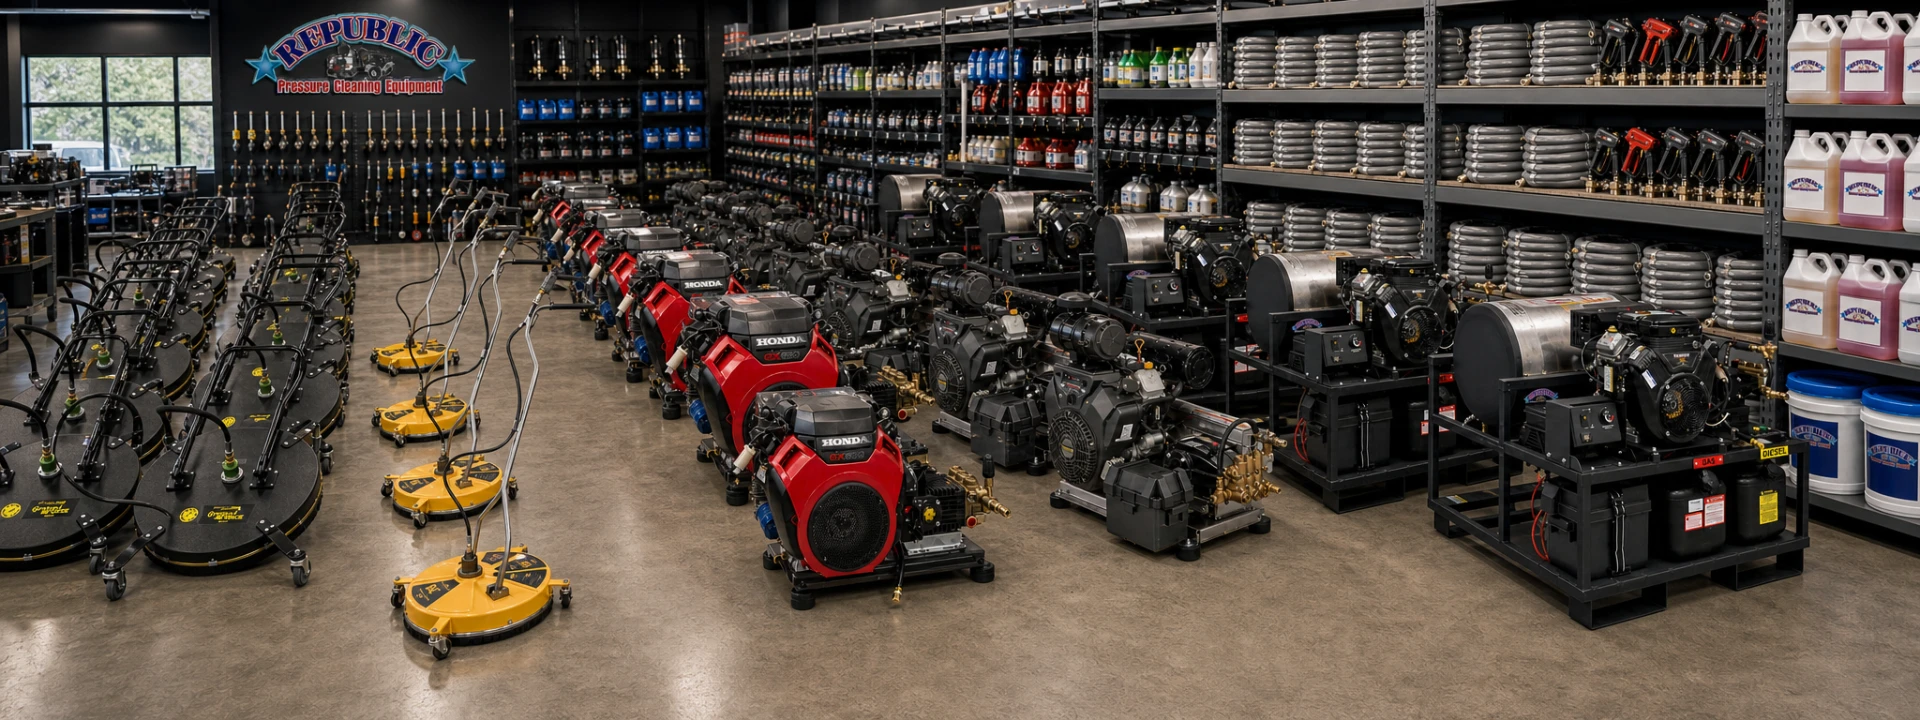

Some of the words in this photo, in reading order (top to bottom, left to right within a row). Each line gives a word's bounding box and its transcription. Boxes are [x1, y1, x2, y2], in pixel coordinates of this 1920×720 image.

[271, 15, 446, 69] REPUBLIC
[277, 79, 329, 94] Pressure
[333, 79, 381, 95] Cleaning
[385, 79, 443, 95] Equipment
[684, 280, 723, 289] HONDA
[756, 335, 807, 347] HONDA
[822, 436, 868, 447] HONDA
[1762, 446, 1786, 458] DIESEL
